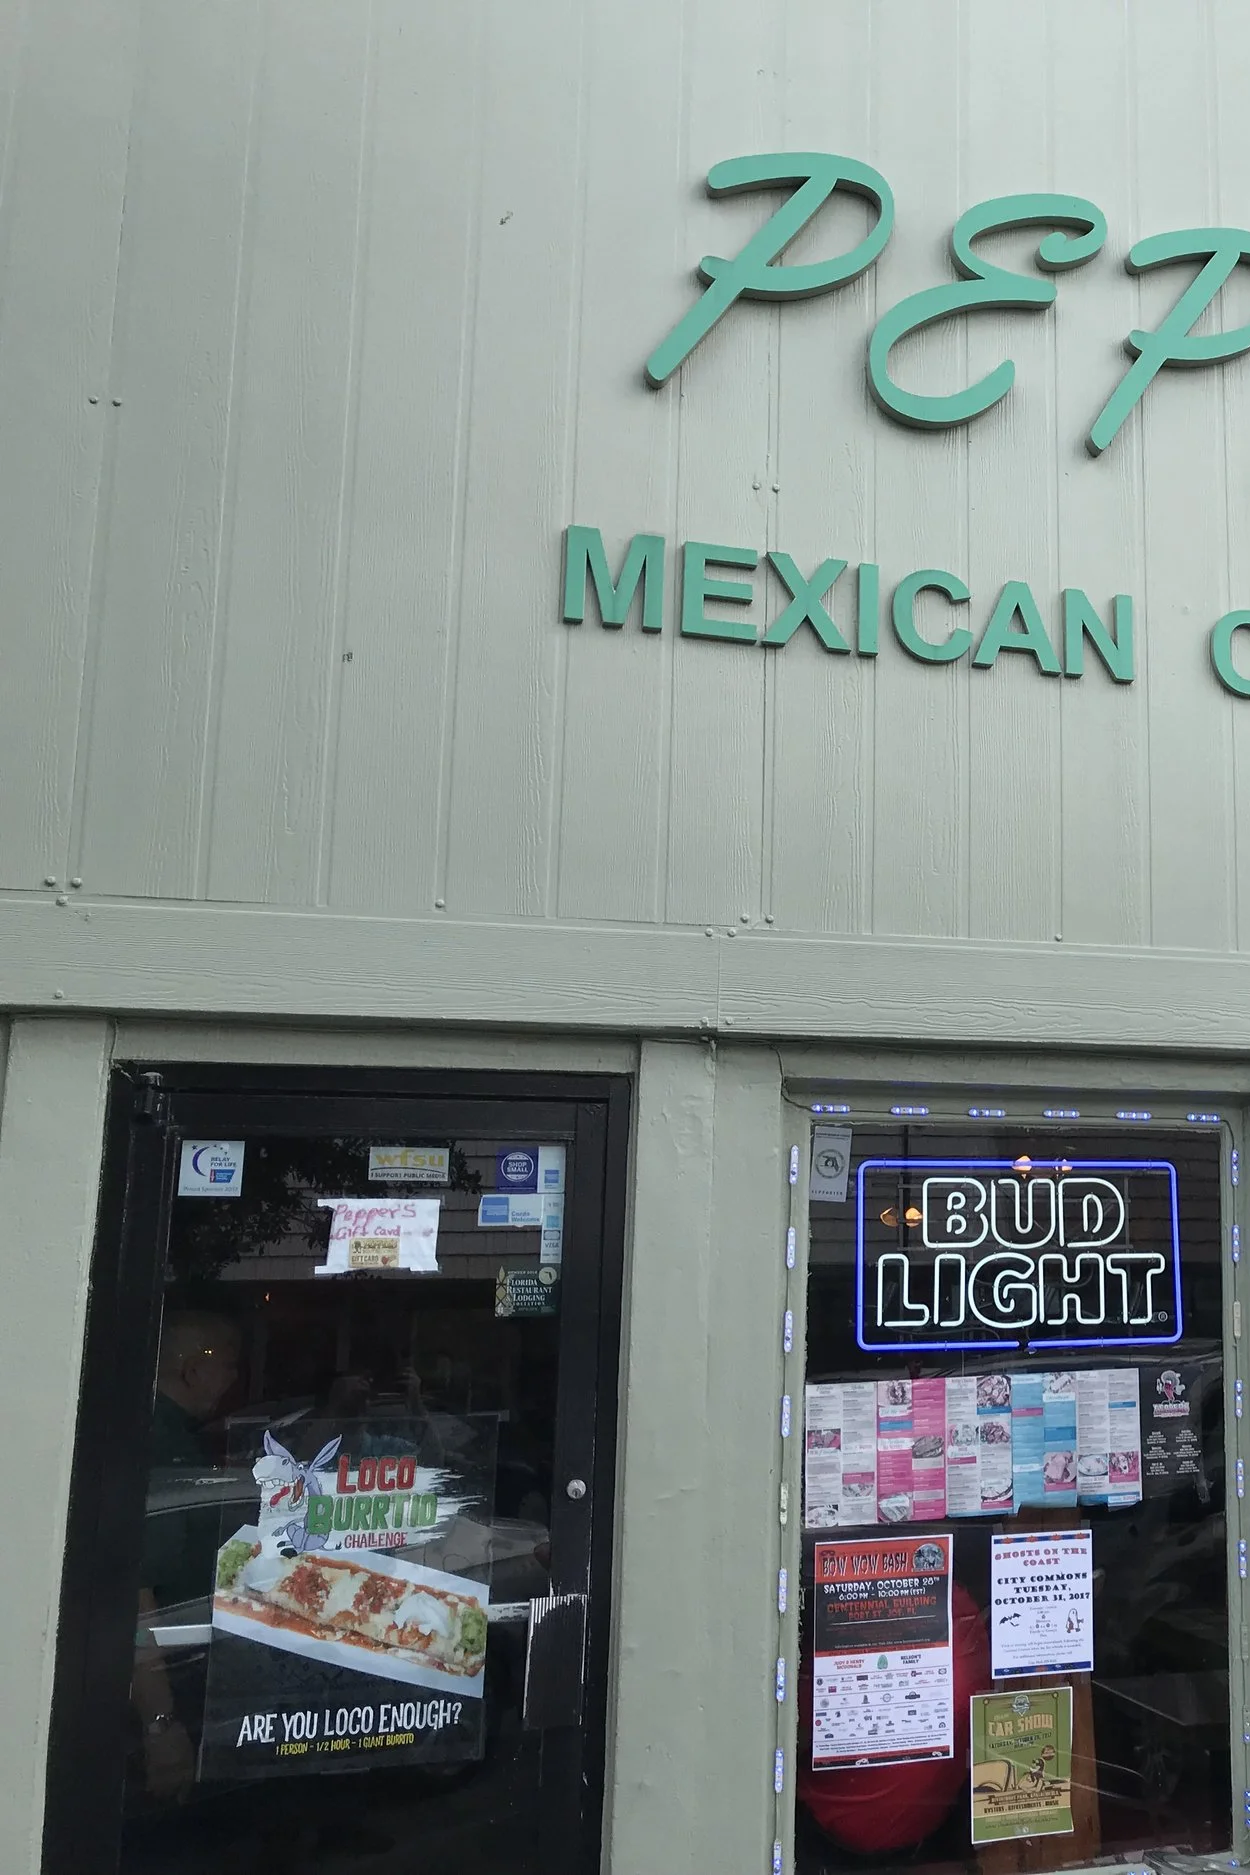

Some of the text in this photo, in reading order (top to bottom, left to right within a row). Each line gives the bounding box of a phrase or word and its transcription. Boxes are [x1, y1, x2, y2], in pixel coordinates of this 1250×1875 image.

[563, 524, 1135, 684] MEXICAN
[376, 1149, 444, 1167] wfsu
[923, 1177, 1125, 1249] BUD
[506, 1286, 553, 1294] RESTAURANT
[513, 1293, 546, 1302] LODGING
[876, 1251, 1165, 1329] LIGHT
[336, 1453, 418, 1494] LOCO
[344, 1531, 408, 1549] CHALLENGE
[994, 1547, 1088, 1561] GHOSTS ON THE
[1023, 1558, 1060, 1567] COAST
[822, 1552, 909, 1577] BOW WOW BASH
[823, 1581, 875, 1594] SATURDAY,
[876, 1578, 920, 1590] OCTOBER
[997, 1572, 1088, 1585] CITY COMMONS
[838, 1593, 859, 1601] 6:00
[859, 1592, 869, 1600] PM
[878, 1589, 899, 1598] 10:00
[1014, 1583, 1072, 1594] TUESDAY,
[826, 1596, 937, 1614] CENTENNIAL BUILDING
[994, 1592, 1091, 1606] OCTOBER 31, 2017
[848, 1610, 869, 1620] PORT
[236, 1699, 463, 1748] ARE YOU LOCO ENOUGH?
[987, 1713, 1054, 1737] CAR SHOW
[280, 1741, 309, 1756] PERSON
[316, 1741, 329, 1752] 1/2
[330, 1739, 351, 1752] HOUR
[363, 1737, 384, 1749] GIANT
[386, 1732, 415, 1746] BURRITO
